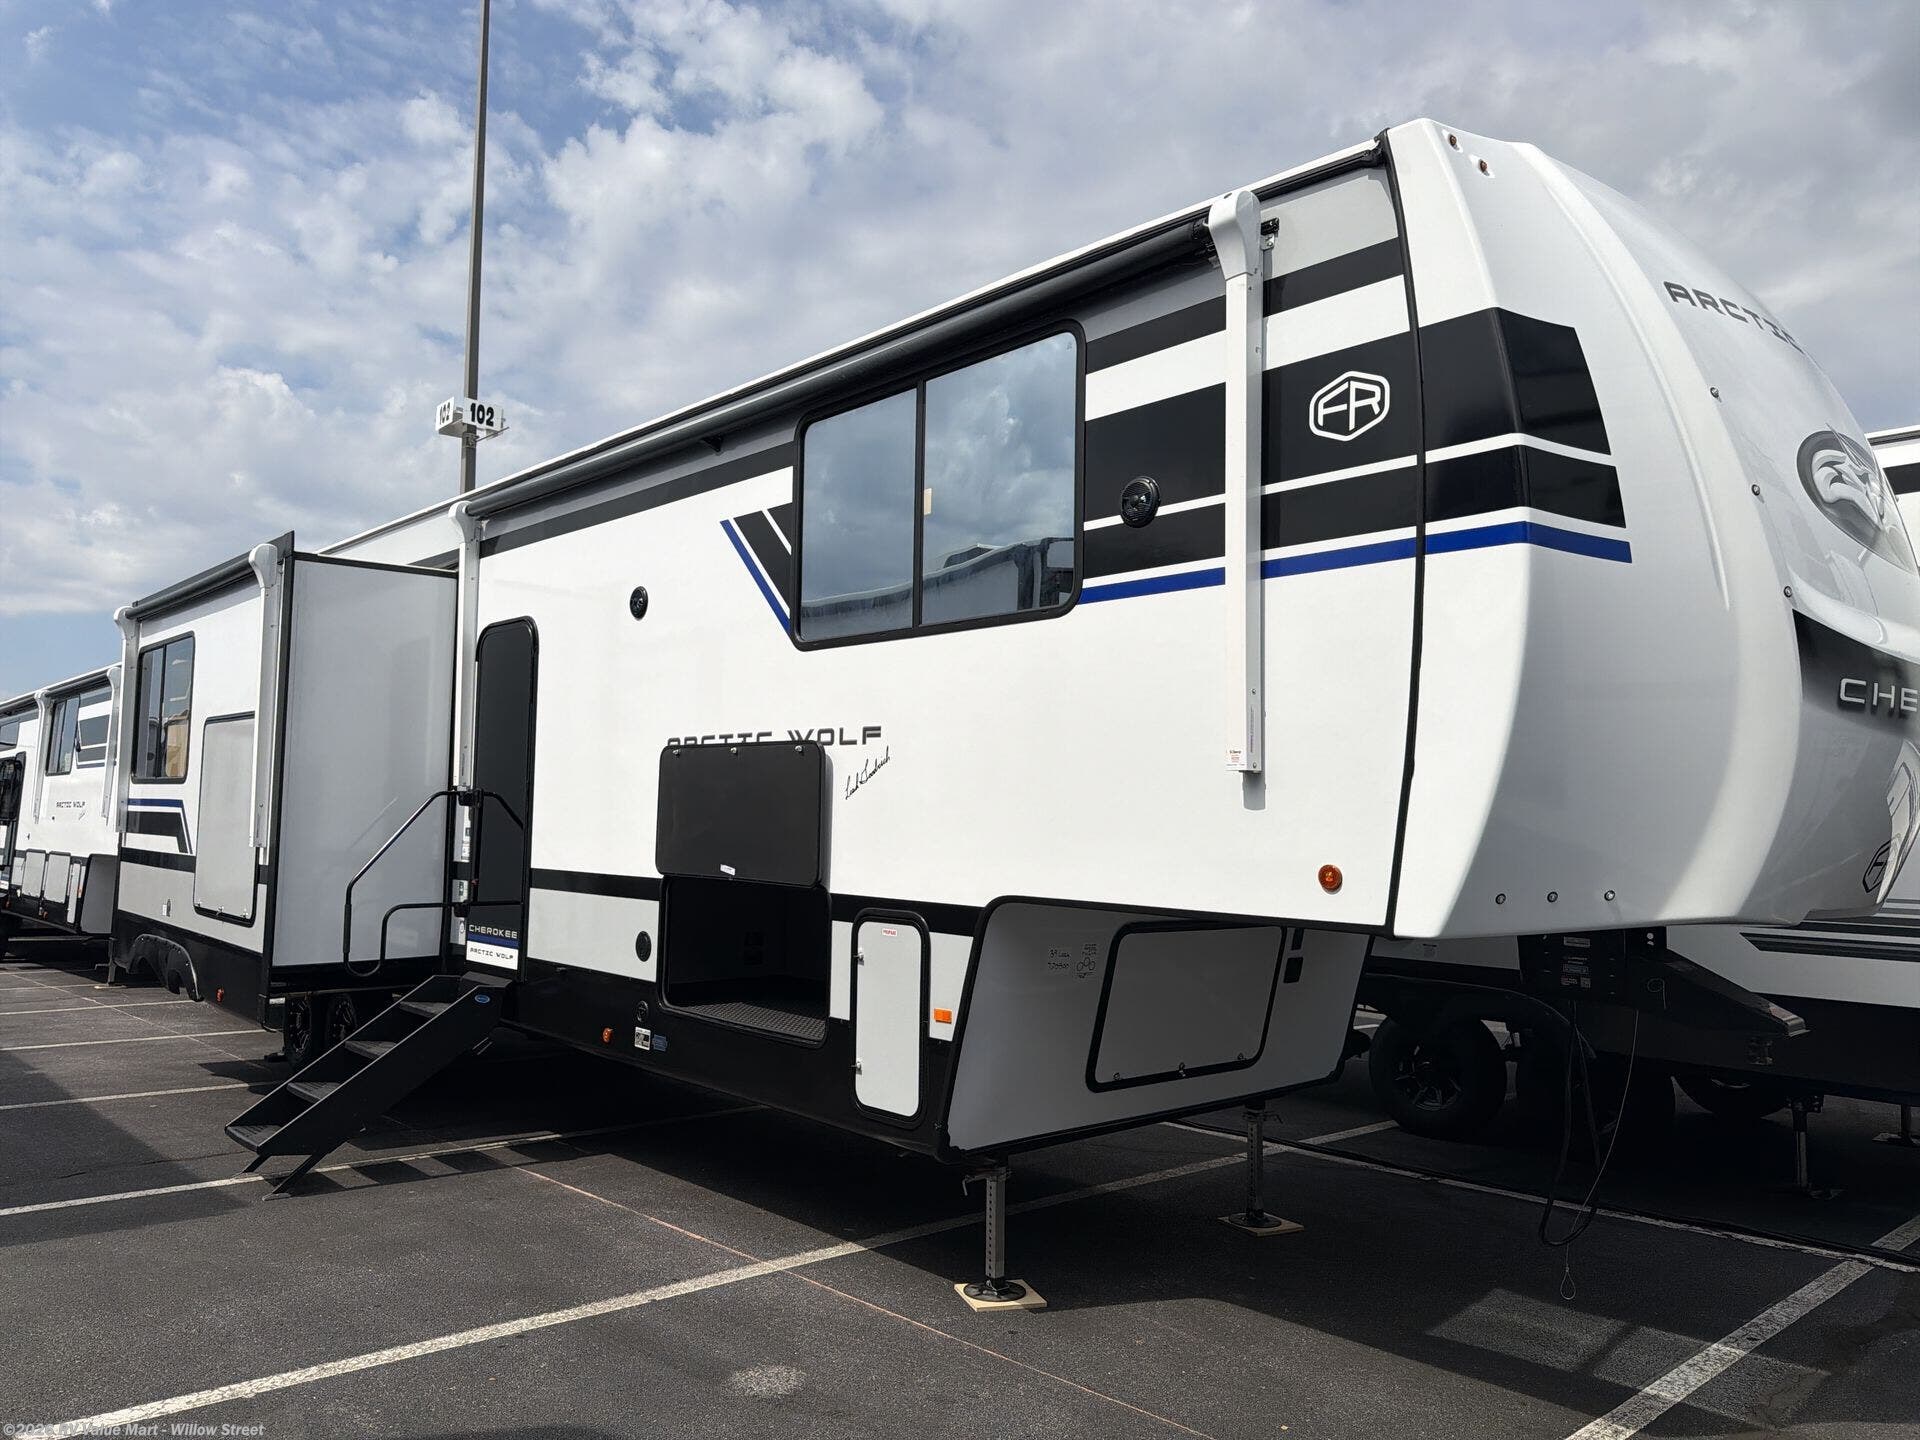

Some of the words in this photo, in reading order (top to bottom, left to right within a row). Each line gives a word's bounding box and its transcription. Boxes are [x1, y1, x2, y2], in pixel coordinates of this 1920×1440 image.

[470, 403, 495, 427] 102
[787, 726, 882, 746] WOLF
[468, 924, 518, 939] CHEROKEE
[470, 947, 493, 957] ARCTIC
[496, 952, 514, 960] WOLF
